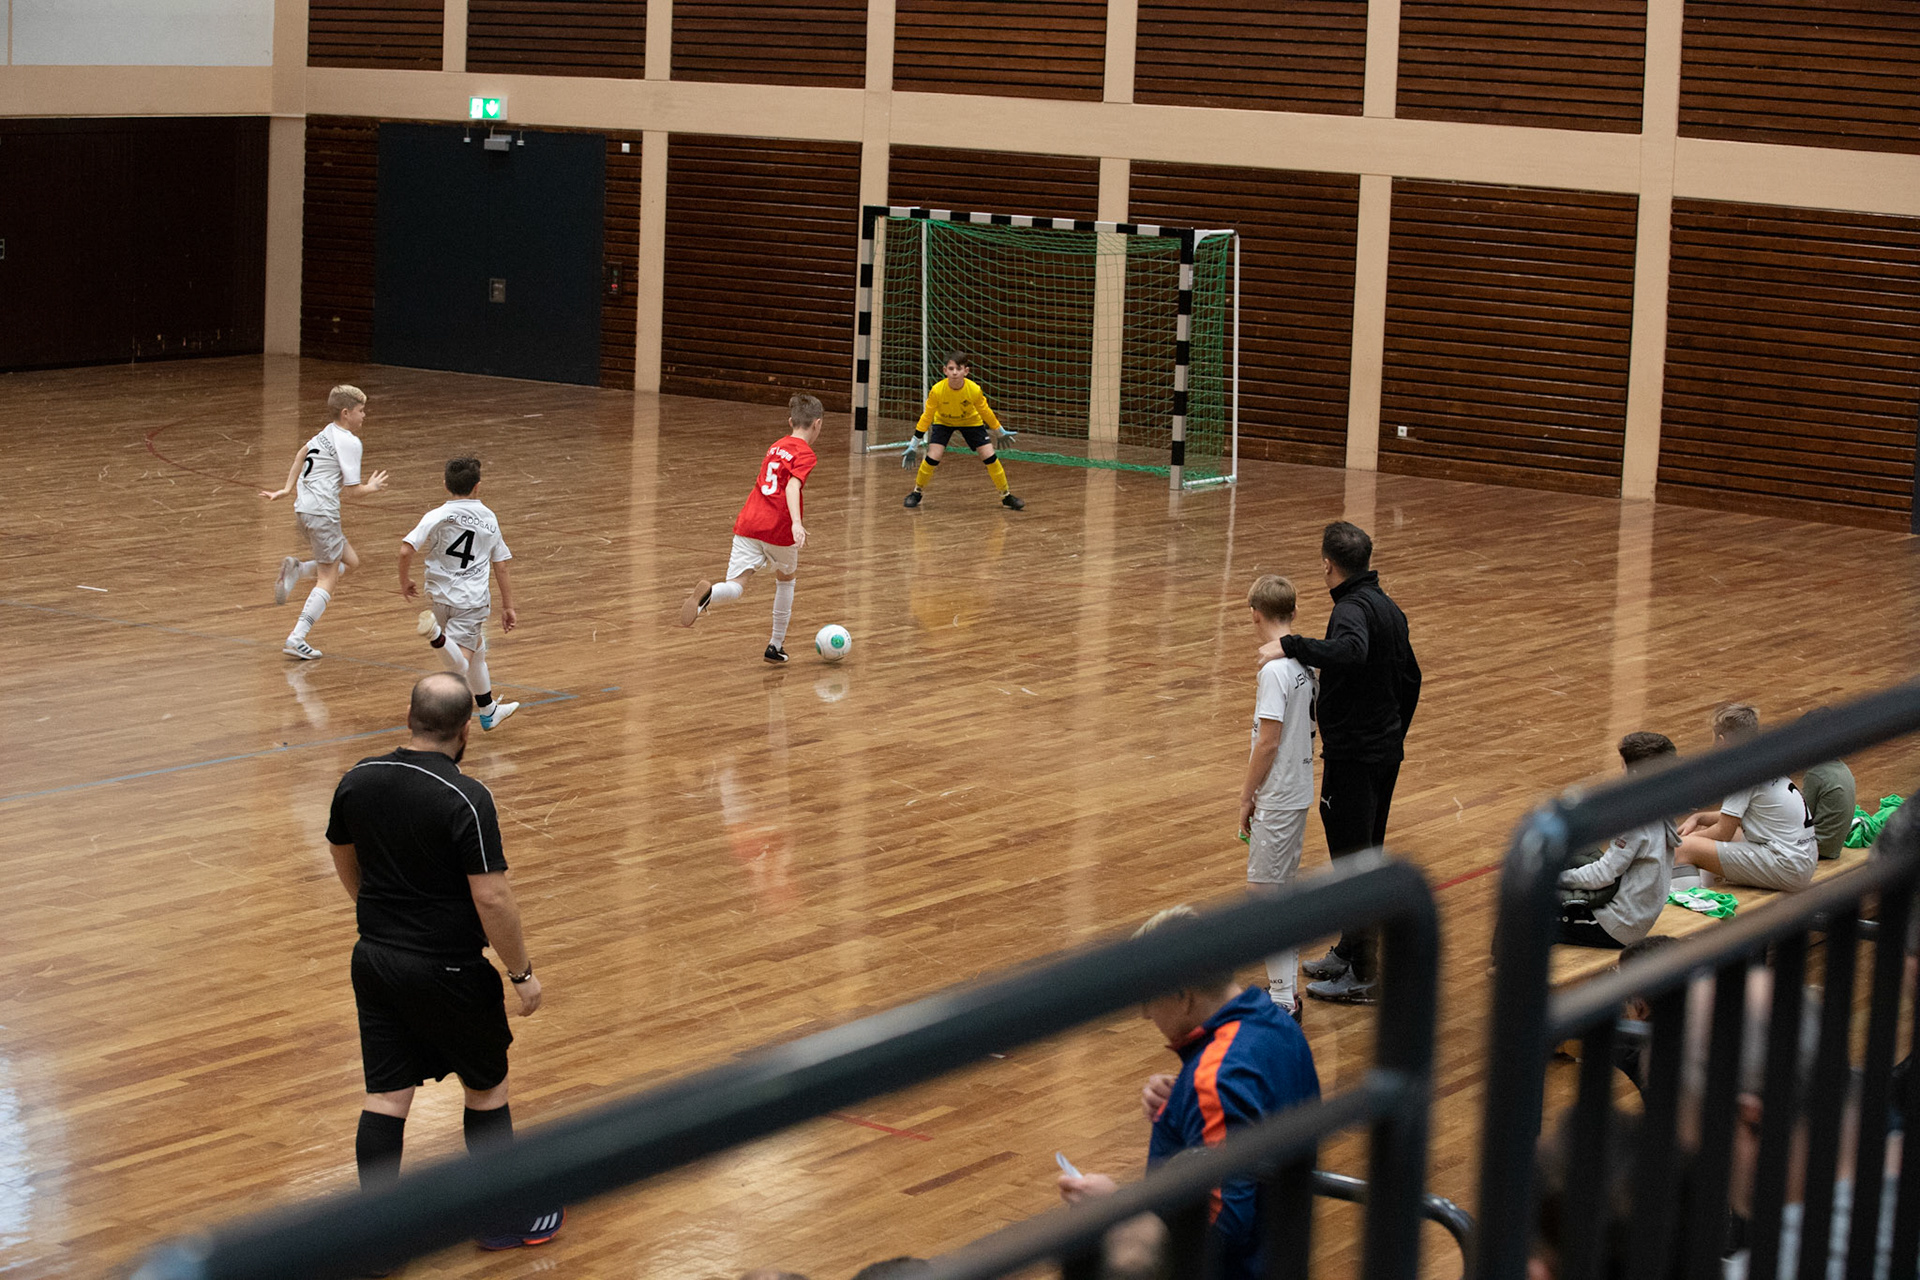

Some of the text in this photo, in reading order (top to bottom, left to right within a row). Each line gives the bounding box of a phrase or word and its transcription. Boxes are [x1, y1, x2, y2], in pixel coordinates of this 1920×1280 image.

[761, 461, 780, 496] 5
[445, 529, 475, 569] 4
[1787, 782, 1814, 829] 2
